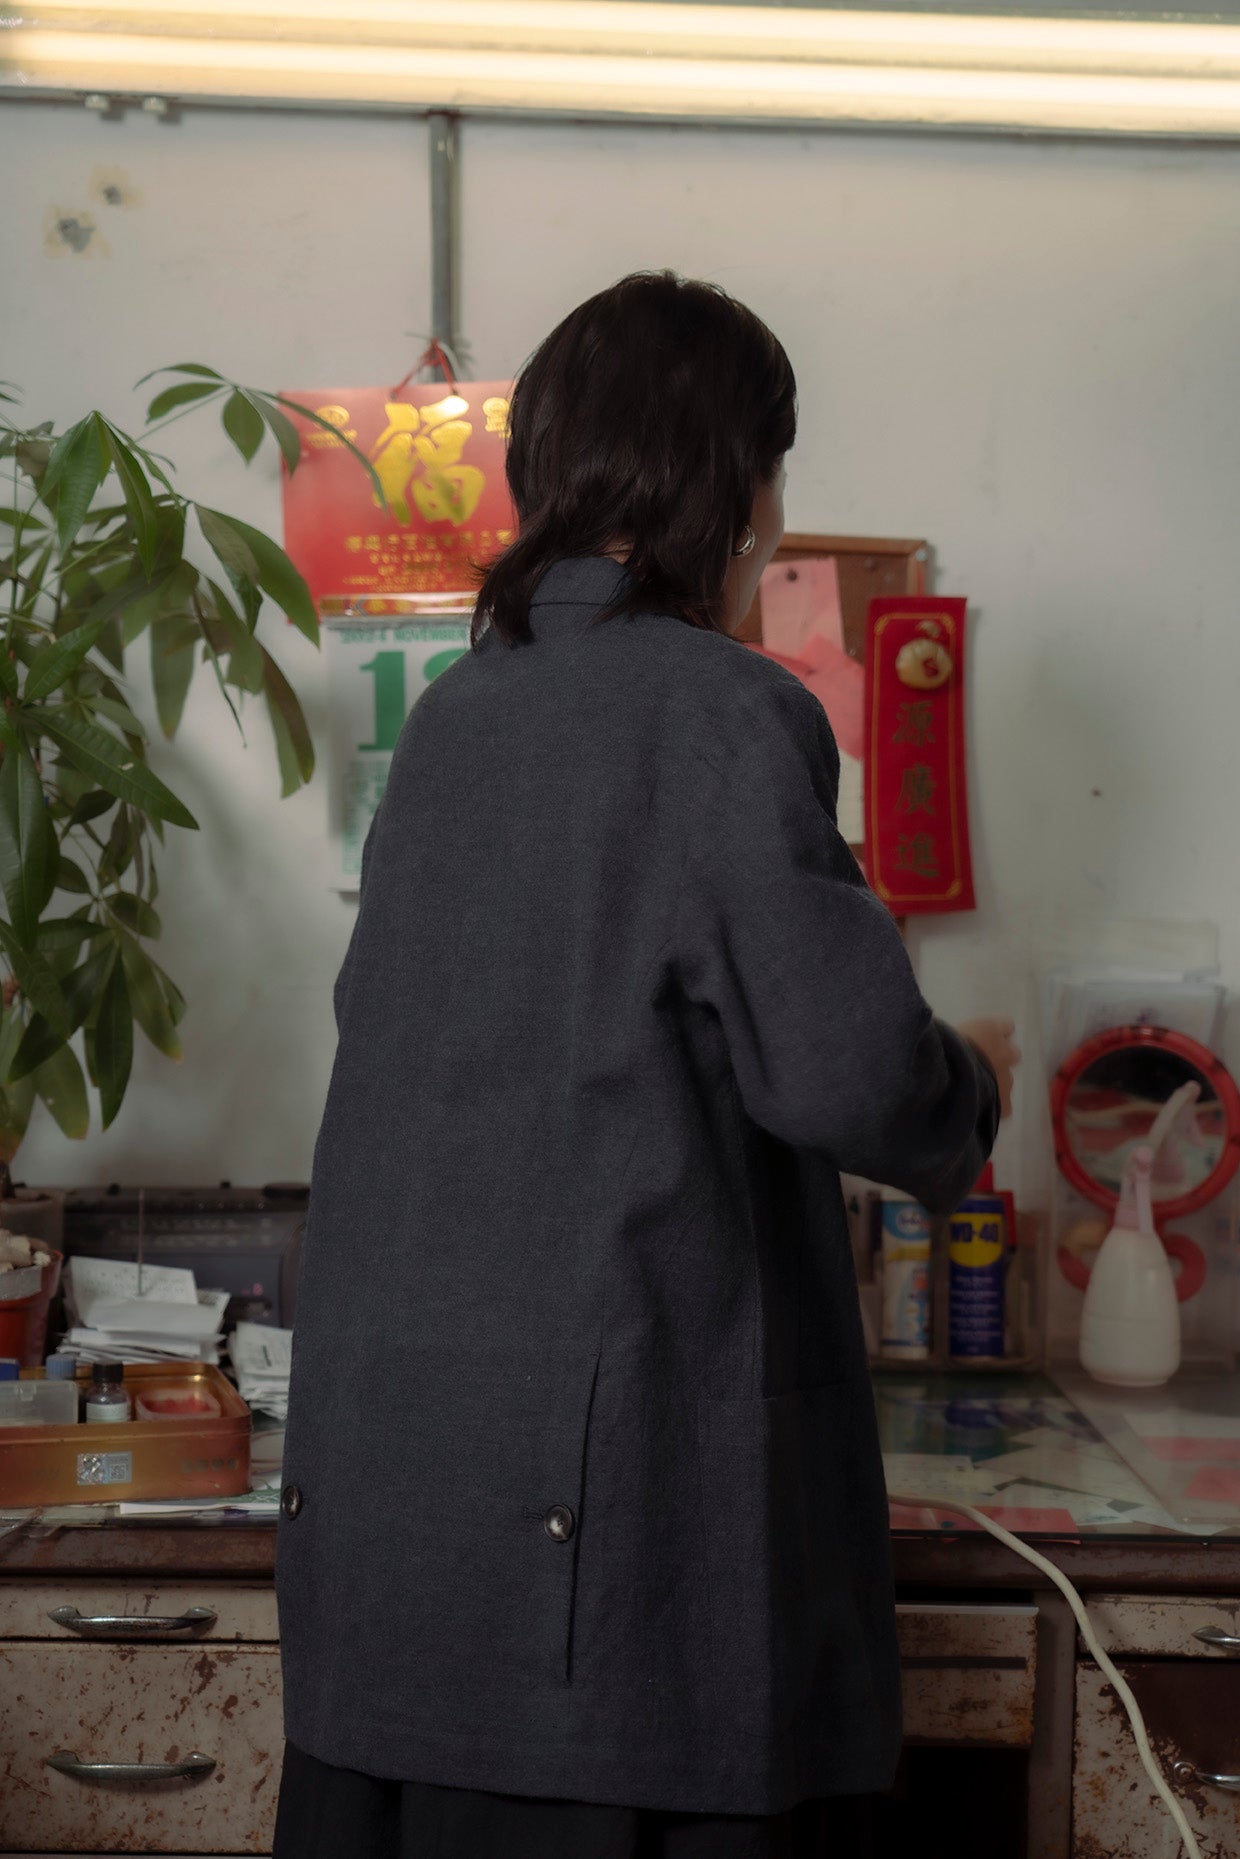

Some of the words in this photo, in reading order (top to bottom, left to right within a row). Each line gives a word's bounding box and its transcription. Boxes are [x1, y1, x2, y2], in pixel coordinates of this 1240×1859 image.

[393, 625, 467, 642] NOVEMBER
[891, 699, 940, 879] 源廣進
[949, 1221, 999, 1243] WD-40
